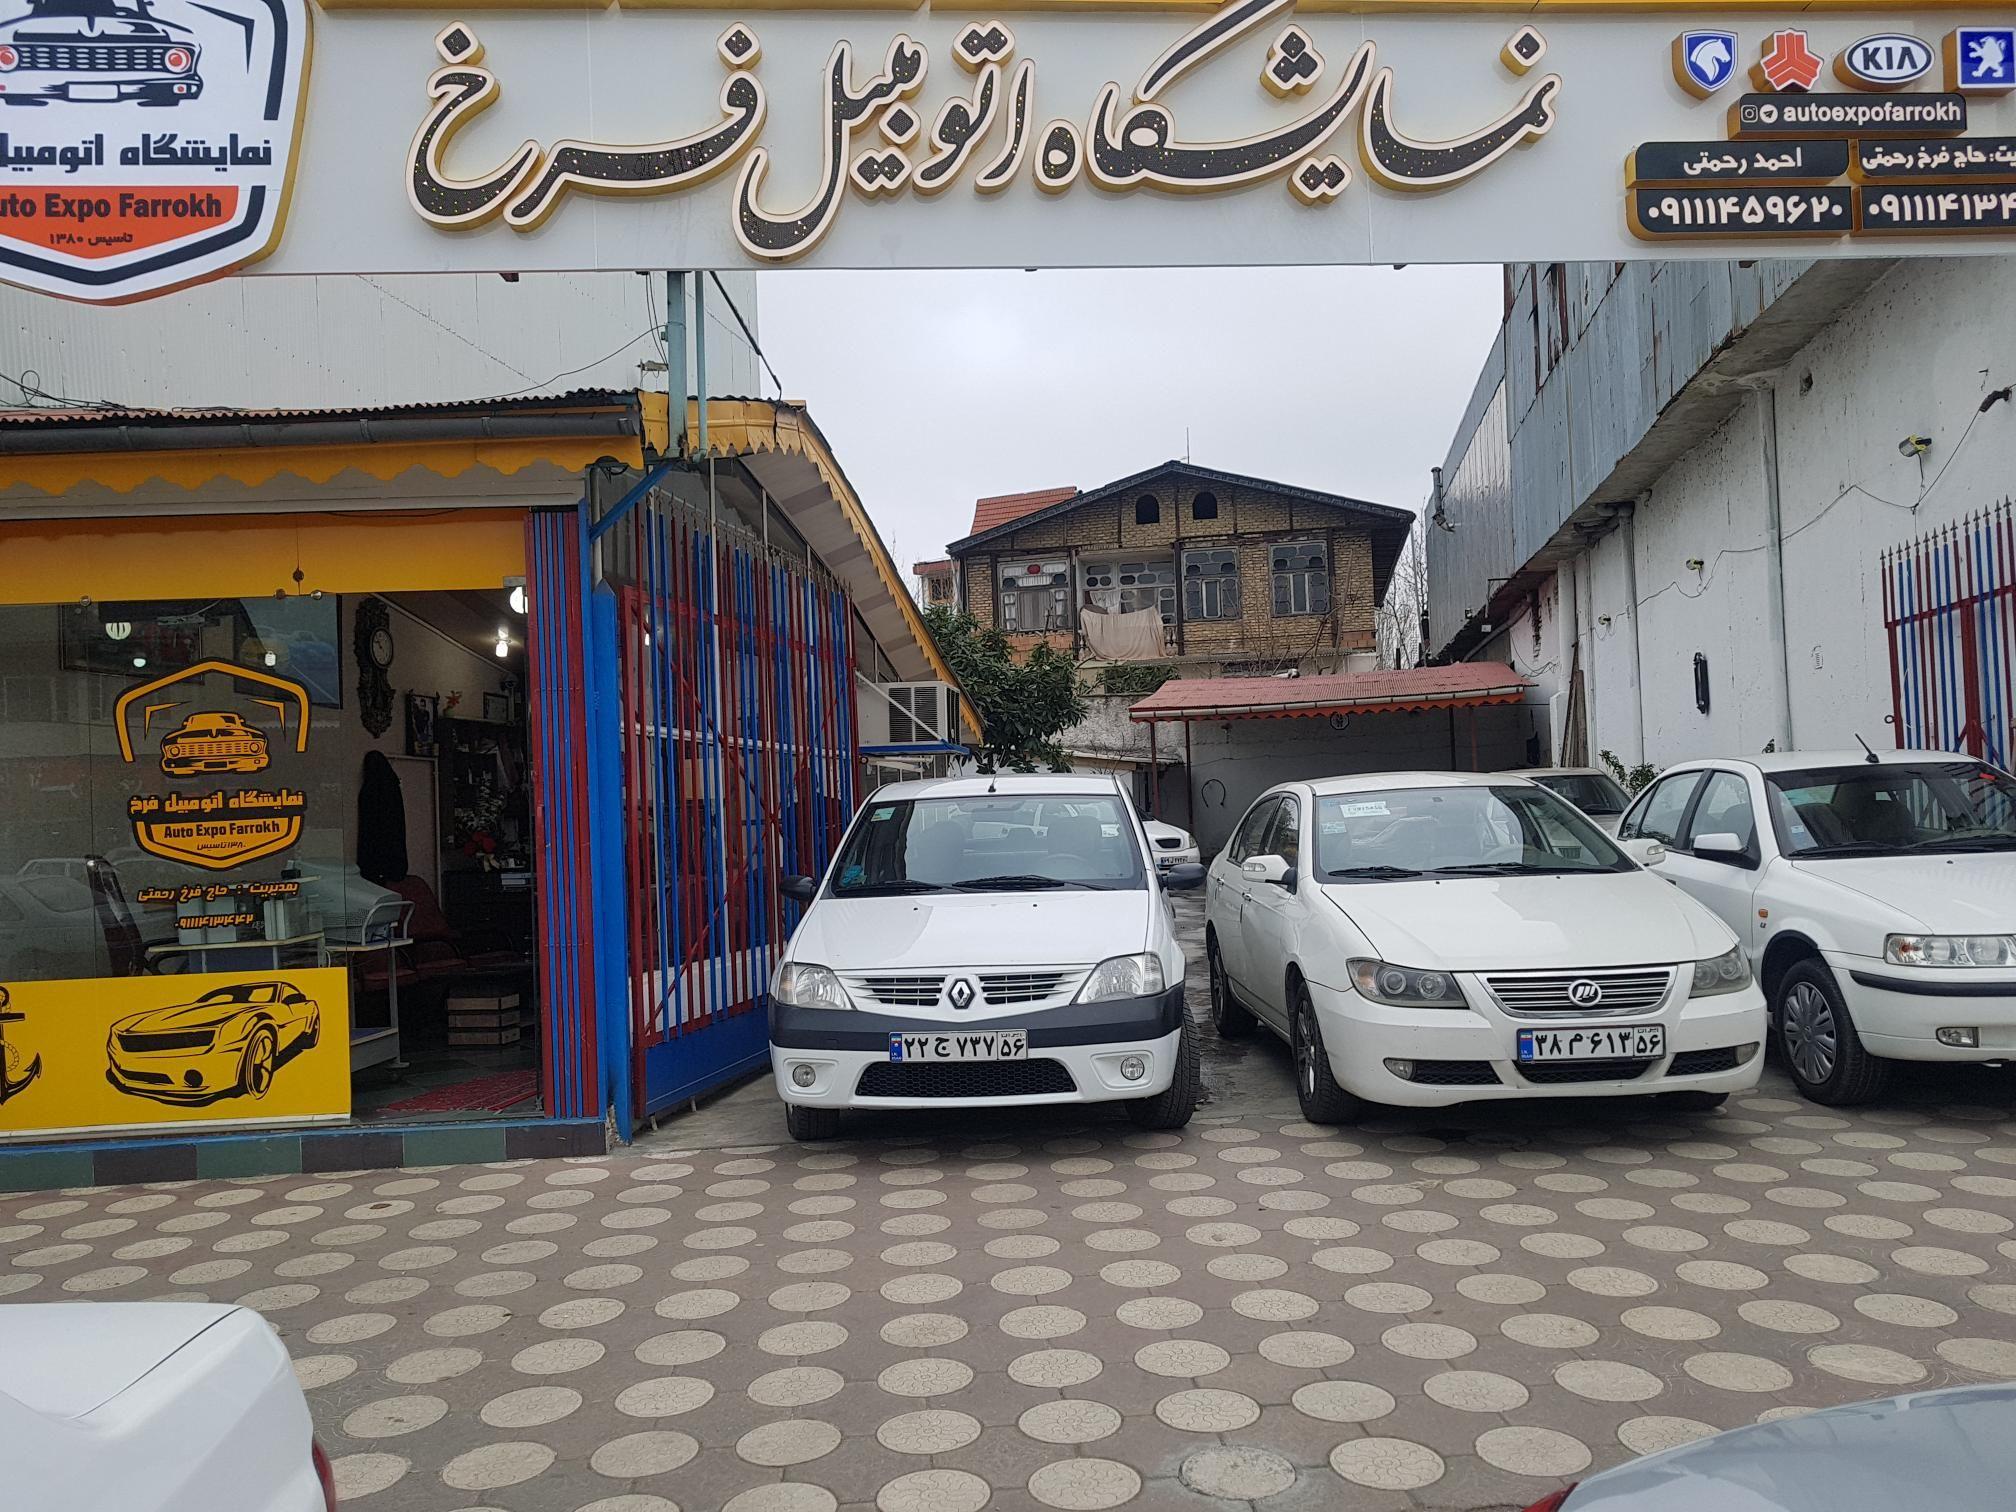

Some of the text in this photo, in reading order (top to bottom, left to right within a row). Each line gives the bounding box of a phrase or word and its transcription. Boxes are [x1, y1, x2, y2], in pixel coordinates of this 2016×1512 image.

[1862, 46, 1918, 71] KIA
[1783, 101, 1961, 125] autoexpofarrokh
[406, 0, 1562, 260] نمایشگاه اتومبیل فرخ
[119, 132, 272, 172] نمایشگاه
[1683, 146, 1802, 176] احمد رحمتی
[1862, 146, 1915, 170] رحمتی
[1917, 145, 1951, 169] فرخ
[1953, 145, 1987, 169] حاج
[44, 193, 110, 222] Expo
[119, 193, 222, 217] Farrokh
[1648, 195, 1843, 225] ۰۹۱۱۱۴۵۹۶۲۰
[50, 232, 84, 245] ۱۳۸۰
[130, 789, 303, 815] نمایشگاه اتومبیل فرخ
[164, 820, 280, 839] Auto Expo Farrokh
[138, 888, 175, 901] رحمتی
[180, 886, 202, 903] فرخ
[206, 885, 228, 901] حاج
